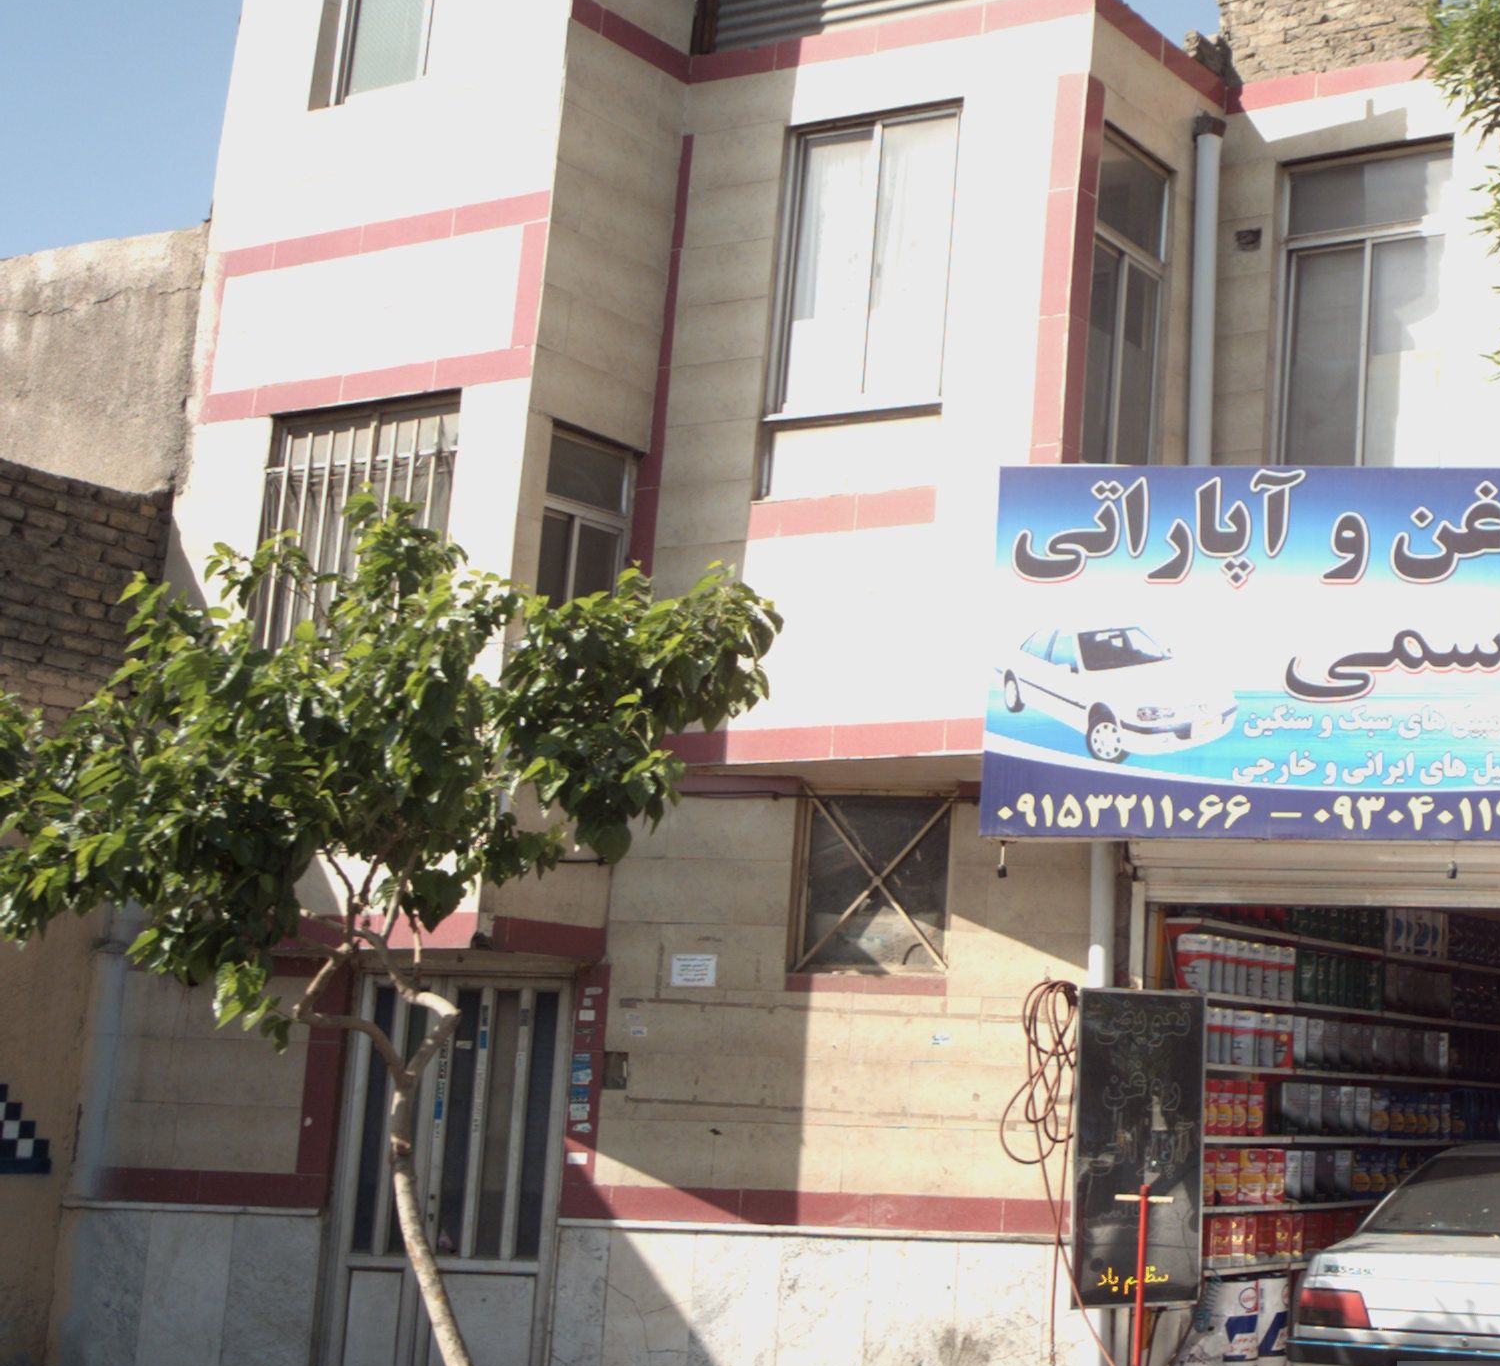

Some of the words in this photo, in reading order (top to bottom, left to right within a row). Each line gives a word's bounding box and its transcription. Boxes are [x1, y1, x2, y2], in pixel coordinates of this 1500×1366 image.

[1011, 469, 1306, 588] آپاراتی
[1320, 511, 1370, 585] و
[1243, 703, 1314, 738] سنگین
[1317, 714, 1334, 739] و
[1338, 704, 1393, 738] سبک
[1398, 704, 1447, 740] های
[1232, 749, 1318, 785] خارجی
[1322, 761, 1338, 786] و
[1342, 750, 1416, 786] ایرانی
[1419, 750, 1469, 786] های
[996, 792, 1252, 830] ۰۹۱۵۳۲۱۱۰۶۶
